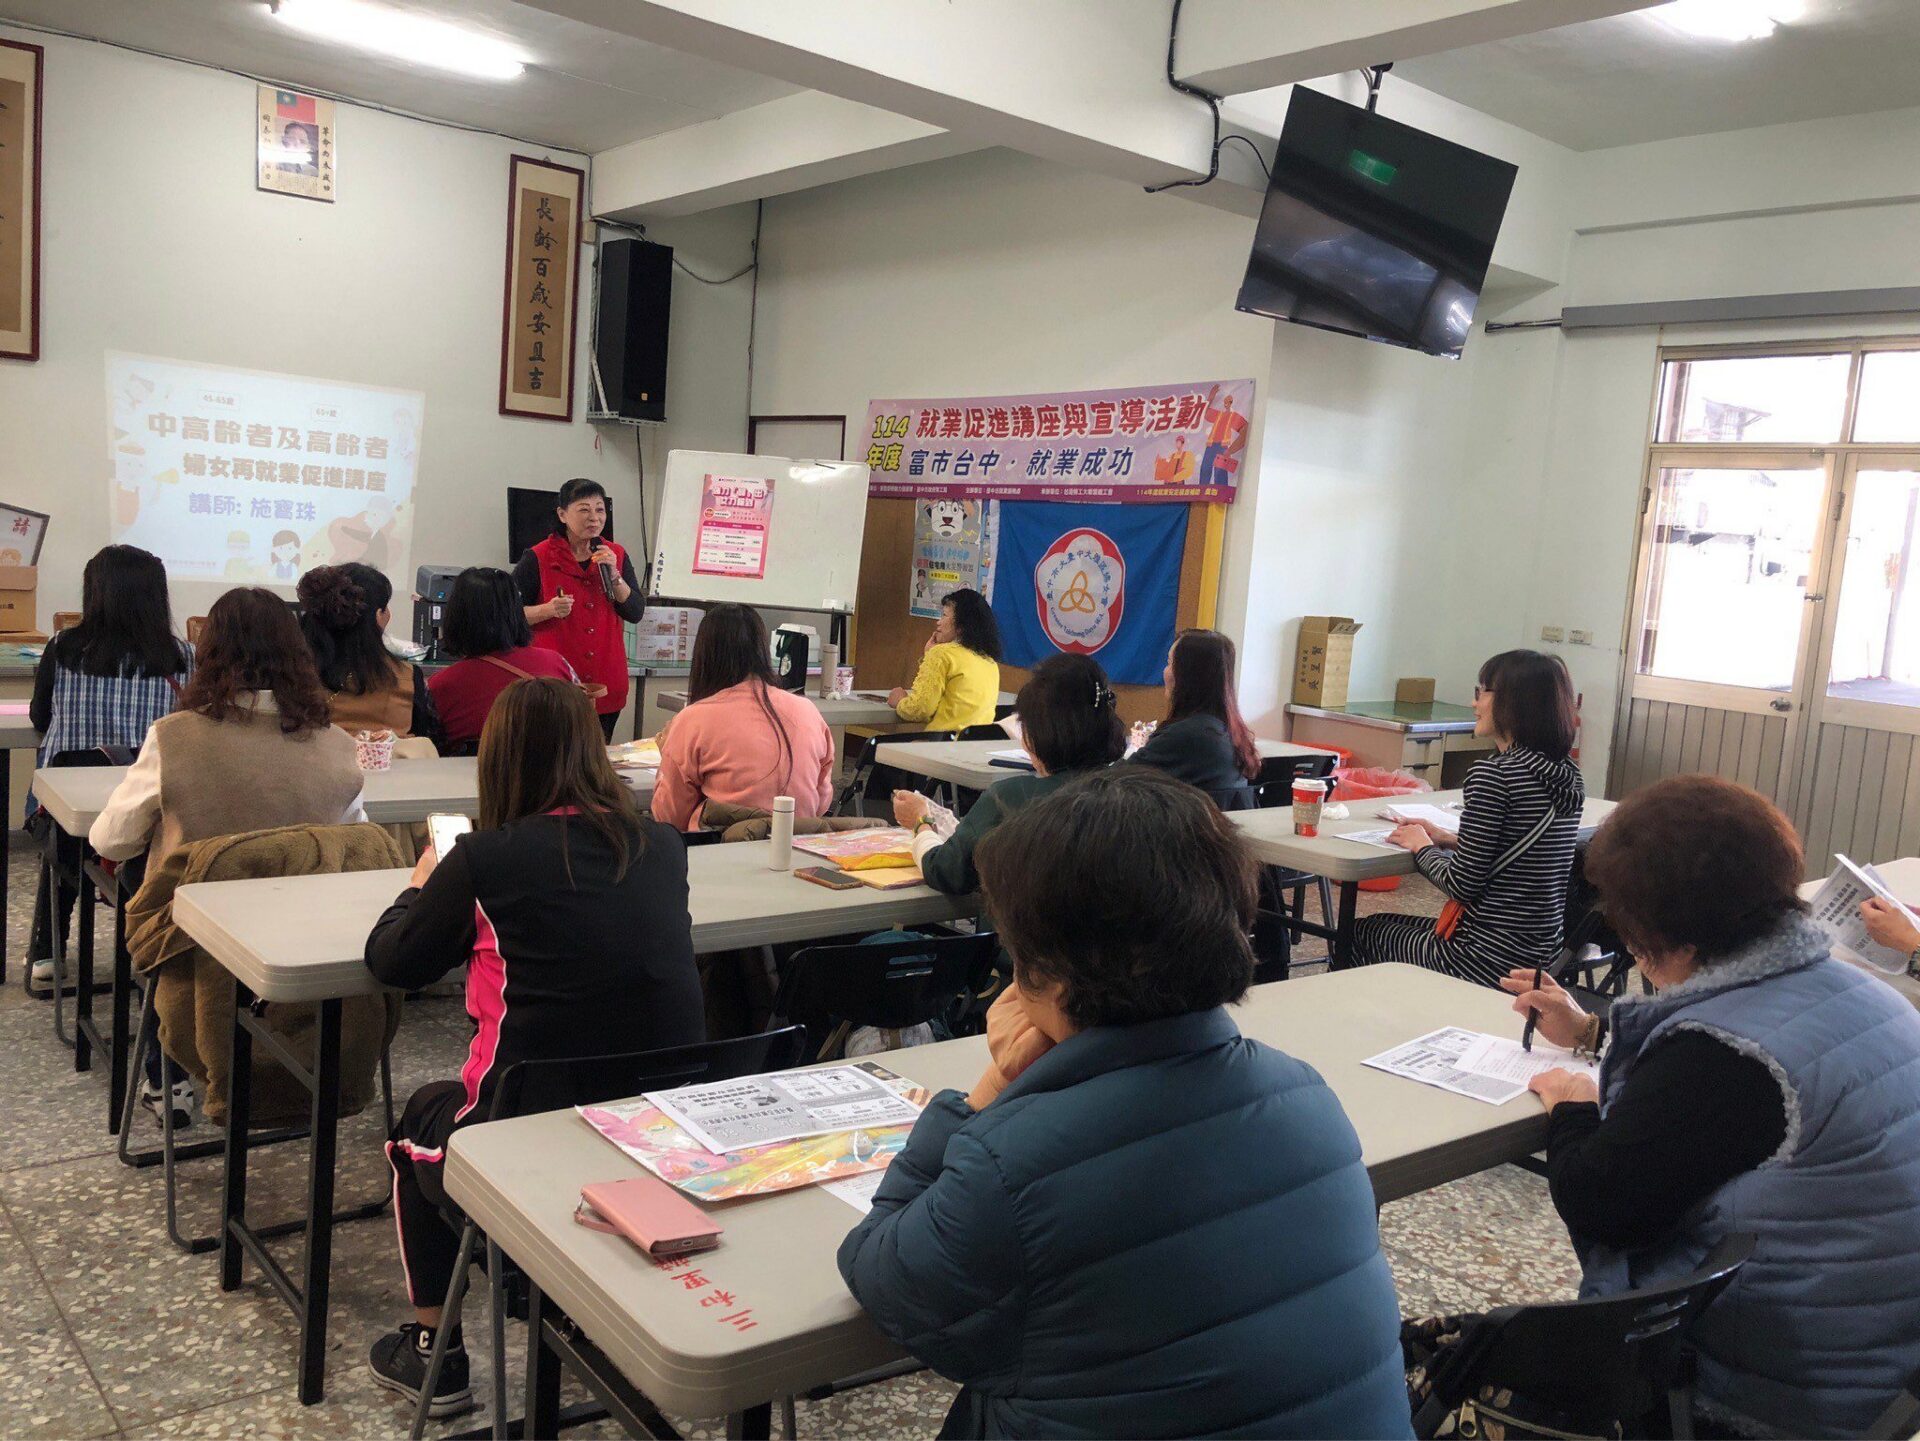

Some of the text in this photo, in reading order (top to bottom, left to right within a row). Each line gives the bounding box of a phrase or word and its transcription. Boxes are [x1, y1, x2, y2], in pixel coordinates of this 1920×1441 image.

[871, 413, 910, 439] 114
[916, 394, 1208, 440] 就業促進講座與宣導活動
[148, 411, 389, 460] 中高齡者及高齡者
[182, 452, 388, 493] 婦女再就業促進講座
[865, 443, 903, 472] 年度
[12, 517, 31, 536] 請
